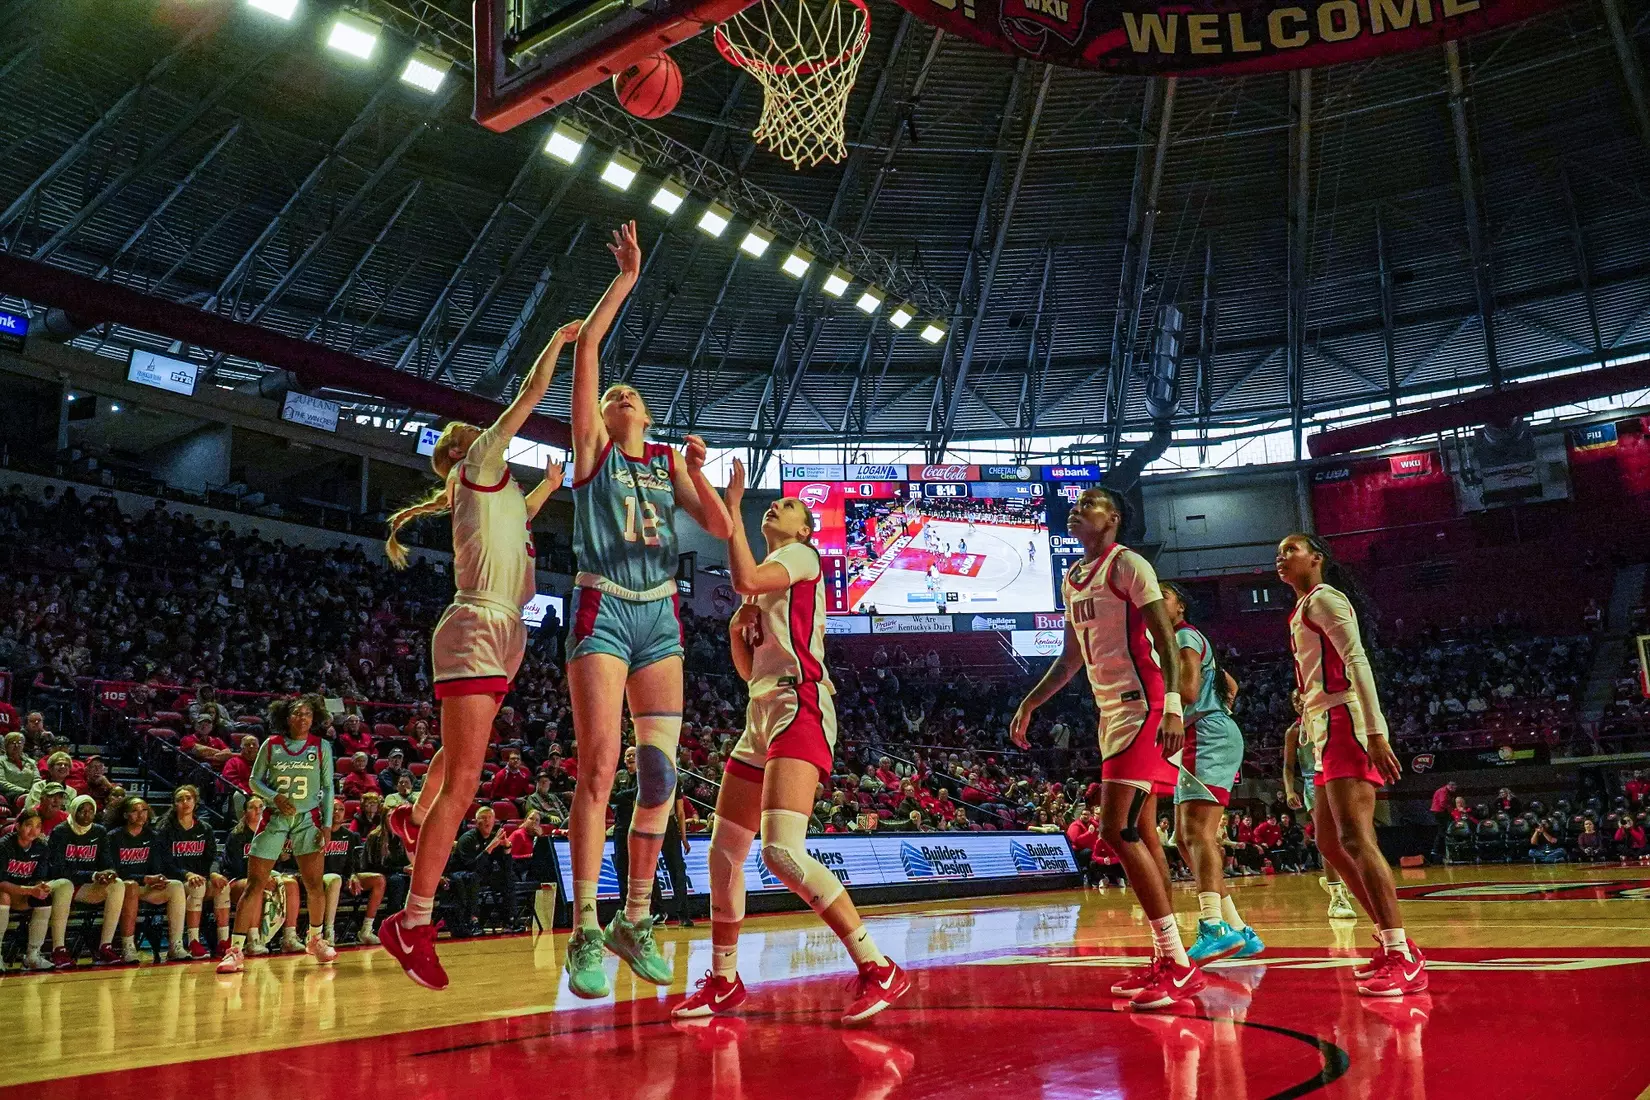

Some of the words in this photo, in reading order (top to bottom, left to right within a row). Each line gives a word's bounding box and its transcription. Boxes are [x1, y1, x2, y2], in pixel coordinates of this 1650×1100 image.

[1586, 431, 1602, 440] FIU
[857, 465, 888, 475] LOGAN
[1400, 460, 1421, 469] WKU
[988, 467, 1017, 475] CHEETAH
[862, 484, 870, 496] 4
[936, 484, 957, 496] 8:14
[1033, 484, 1041, 495] 4
[912, 615, 923, 623] We
[924, 615, 937, 623] Are
[1036, 615, 1065, 629] Bud
[898, 623, 932, 633] Kentucky's
[933, 623, 952, 633] Dairy
[1034, 637, 1063, 647] Kentucky
[103, 691, 126, 701] 105
[276, 776, 308, 800] 23
[65, 843, 98, 858] WKU
[172, 840, 206, 854] WKU
[921, 845, 968, 861] Builders
[1026, 843, 1064, 857] Builders
[119, 847, 150, 862] WKU
[7, 859, 38, 875] WKU
[934, 860, 973, 877] Design
[1038, 857, 1070, 871] Design
